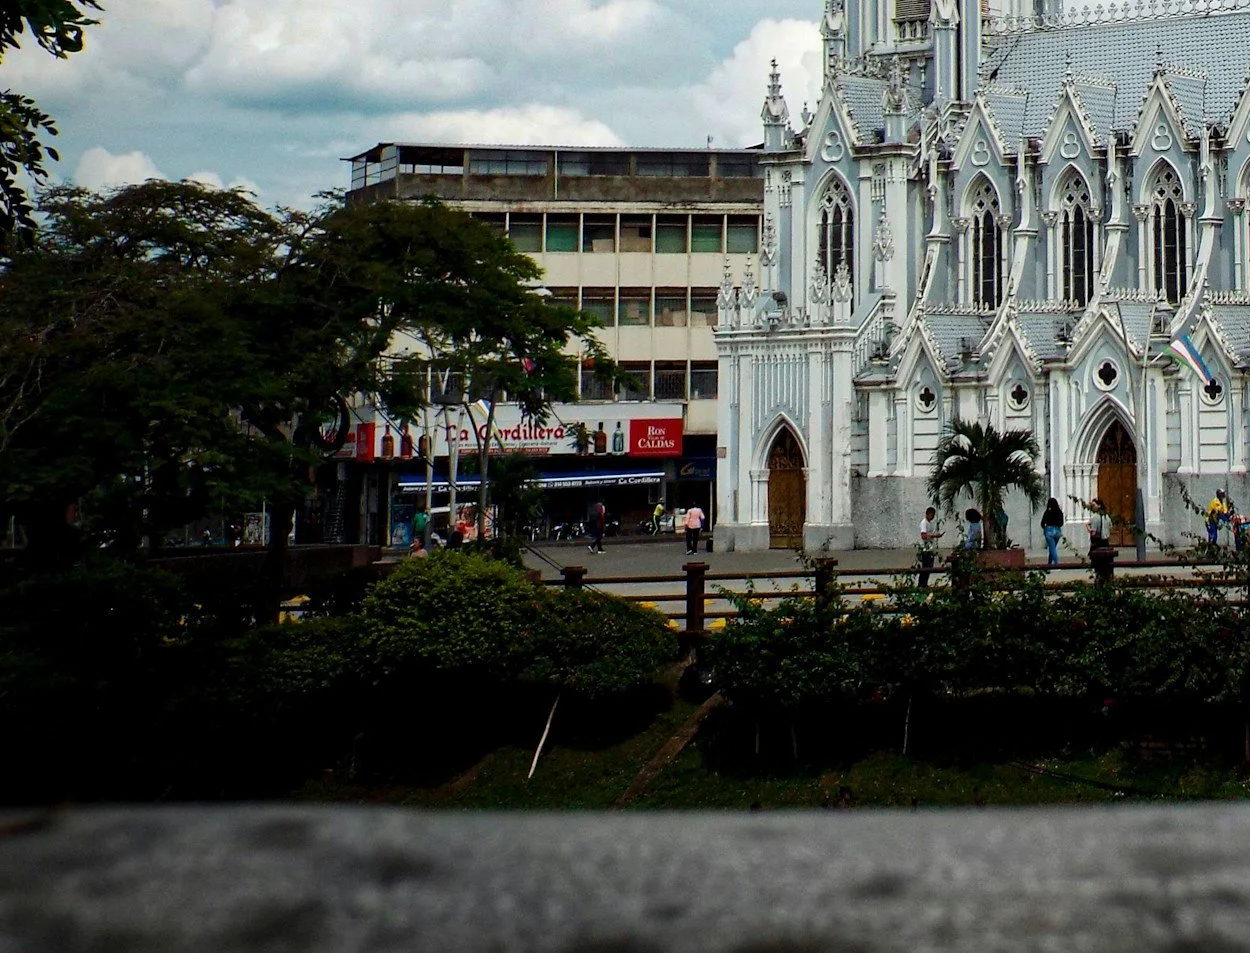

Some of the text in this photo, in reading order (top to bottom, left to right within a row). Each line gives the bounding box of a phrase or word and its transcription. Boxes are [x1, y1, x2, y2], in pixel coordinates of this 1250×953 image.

[445, 424, 469, 442] La
[648, 425, 666, 436] RON
[638, 438, 675, 449] CALDAS
